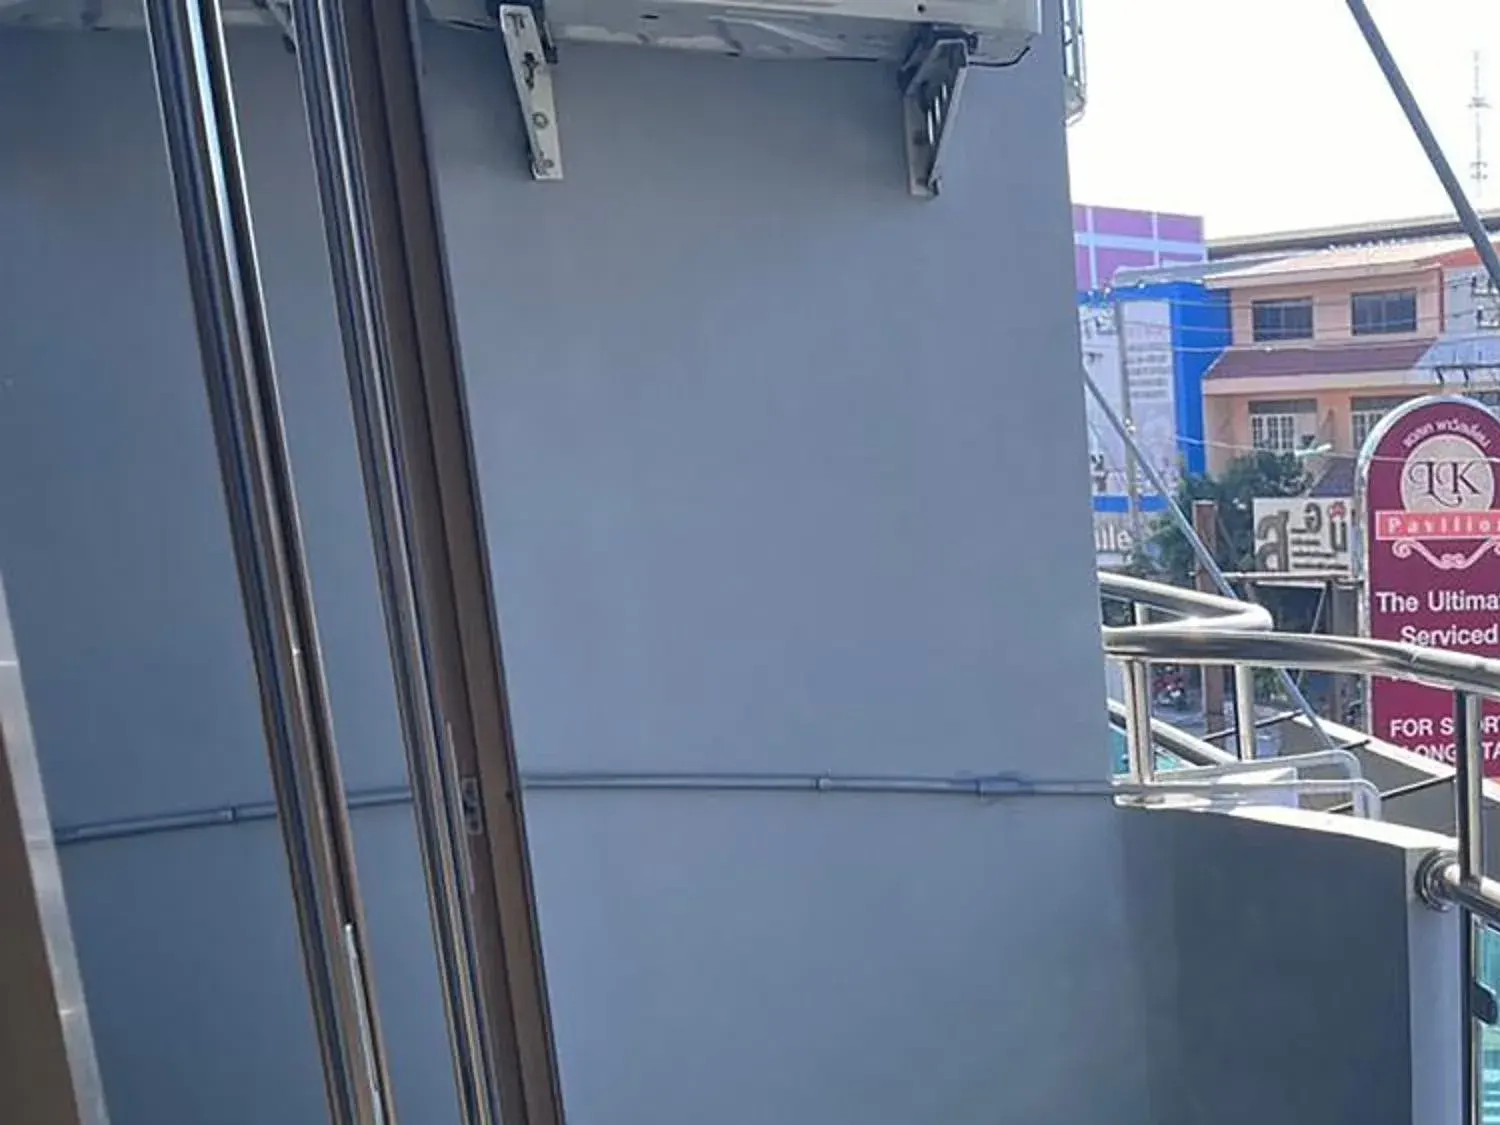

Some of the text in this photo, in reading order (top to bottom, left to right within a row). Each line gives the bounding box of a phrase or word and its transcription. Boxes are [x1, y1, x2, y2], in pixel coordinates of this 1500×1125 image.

[1408, 461, 1481, 508] LK
[1375, 592, 1419, 613] The
[1401, 624, 1499, 646] Serviced
[1390, 719, 1433, 737] FOR
